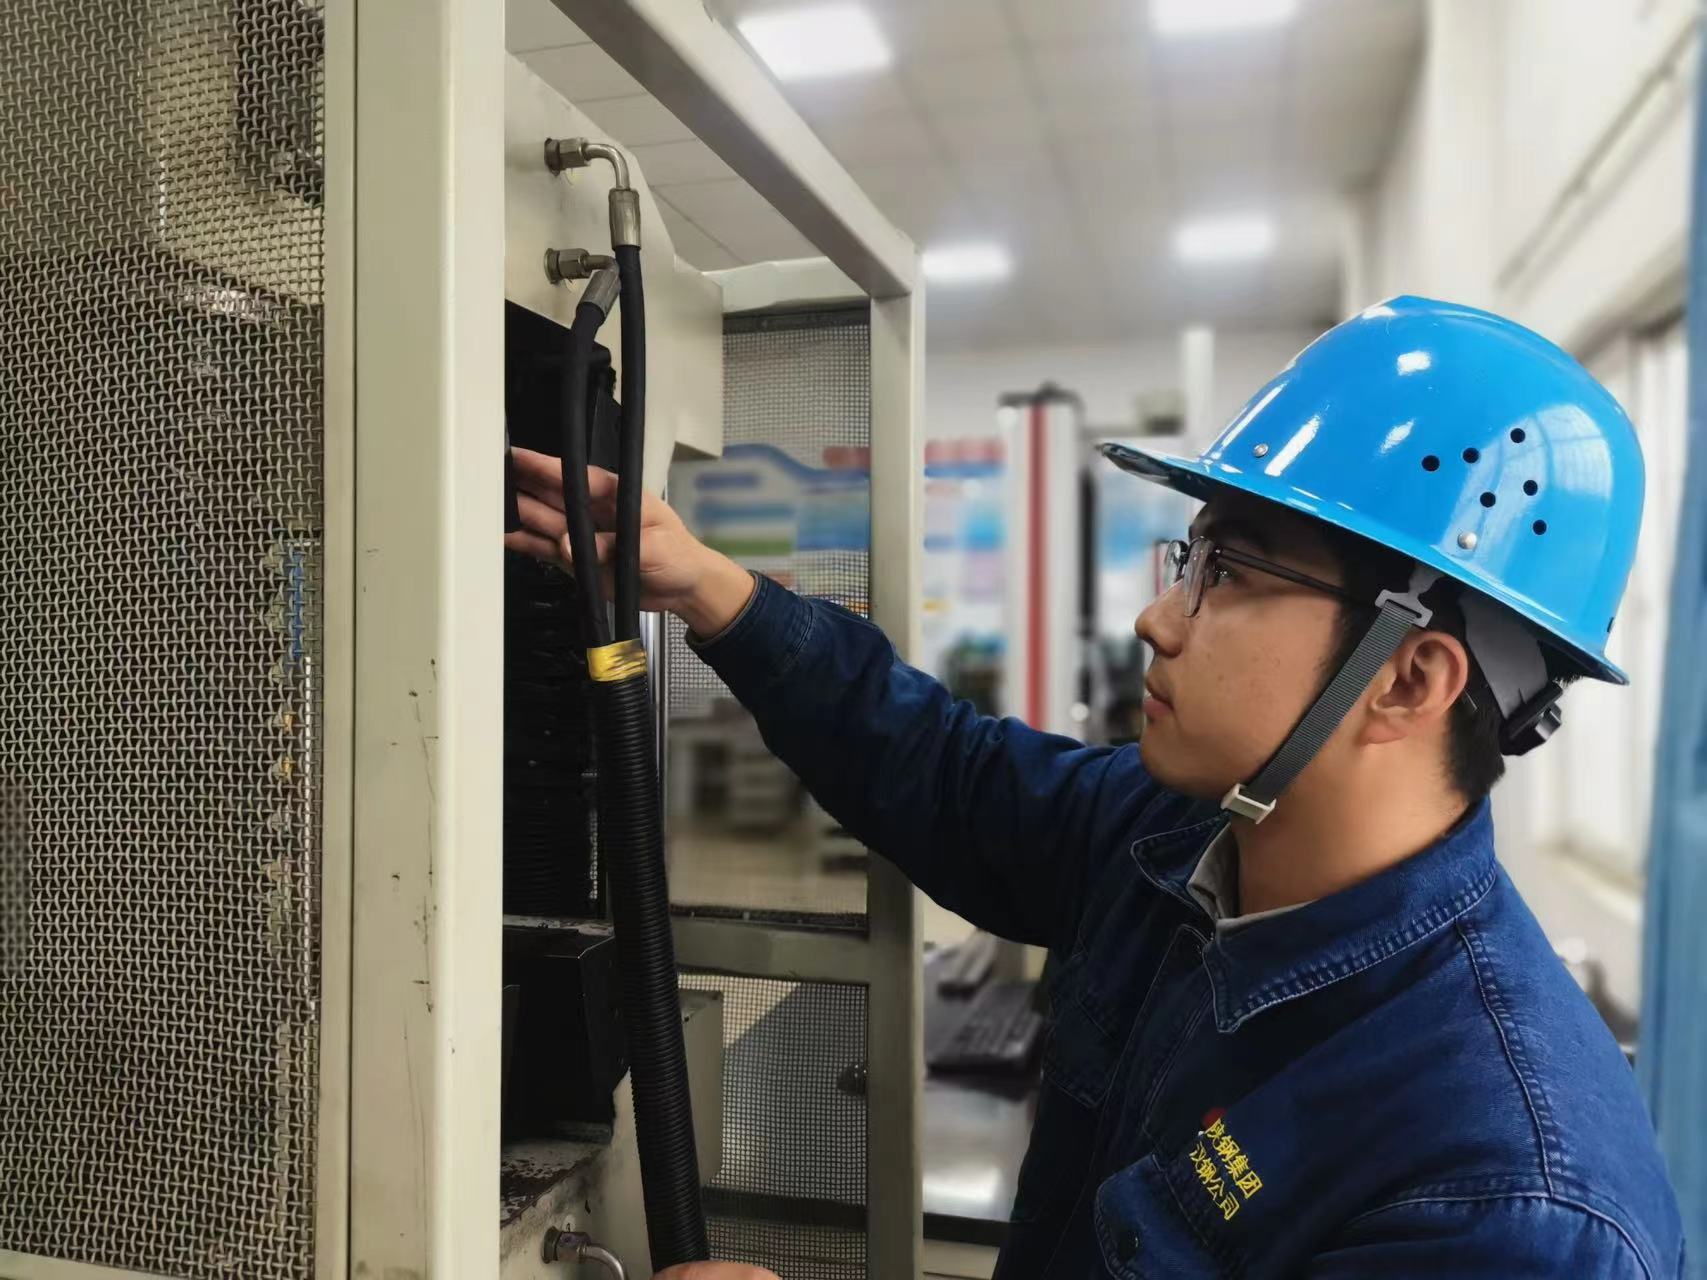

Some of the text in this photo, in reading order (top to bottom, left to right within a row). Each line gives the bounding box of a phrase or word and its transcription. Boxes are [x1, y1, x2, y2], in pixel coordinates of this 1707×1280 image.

[1189, 1140, 1240, 1220] 汉钢公司
[1204, 1118, 1263, 1199] 陕钢集团
